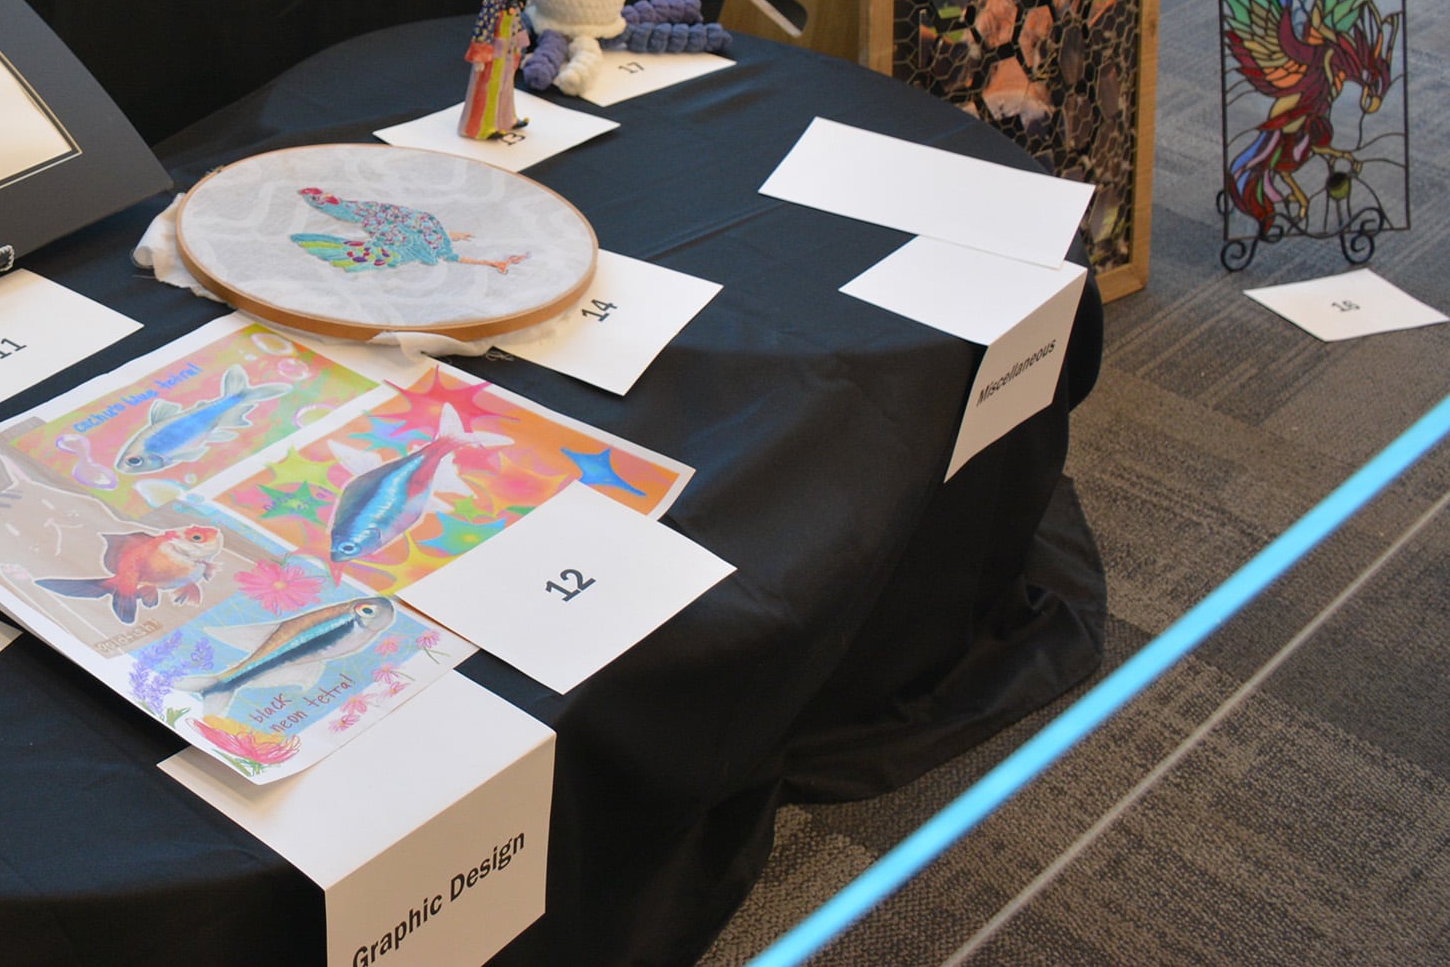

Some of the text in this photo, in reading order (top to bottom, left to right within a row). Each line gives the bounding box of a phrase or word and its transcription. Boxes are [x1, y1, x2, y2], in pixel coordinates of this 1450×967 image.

[618, 61, 645, 74] 17
[581, 298, 617, 322] 14
[976, 339, 1056, 407] Miscellaneous
[121, 388, 159, 407] blue
[544, 569, 597, 602] 12
[249, 693, 293, 724] black
[269, 710, 308, 734] neon
[352, 832, 525, 967] Graphic Design
